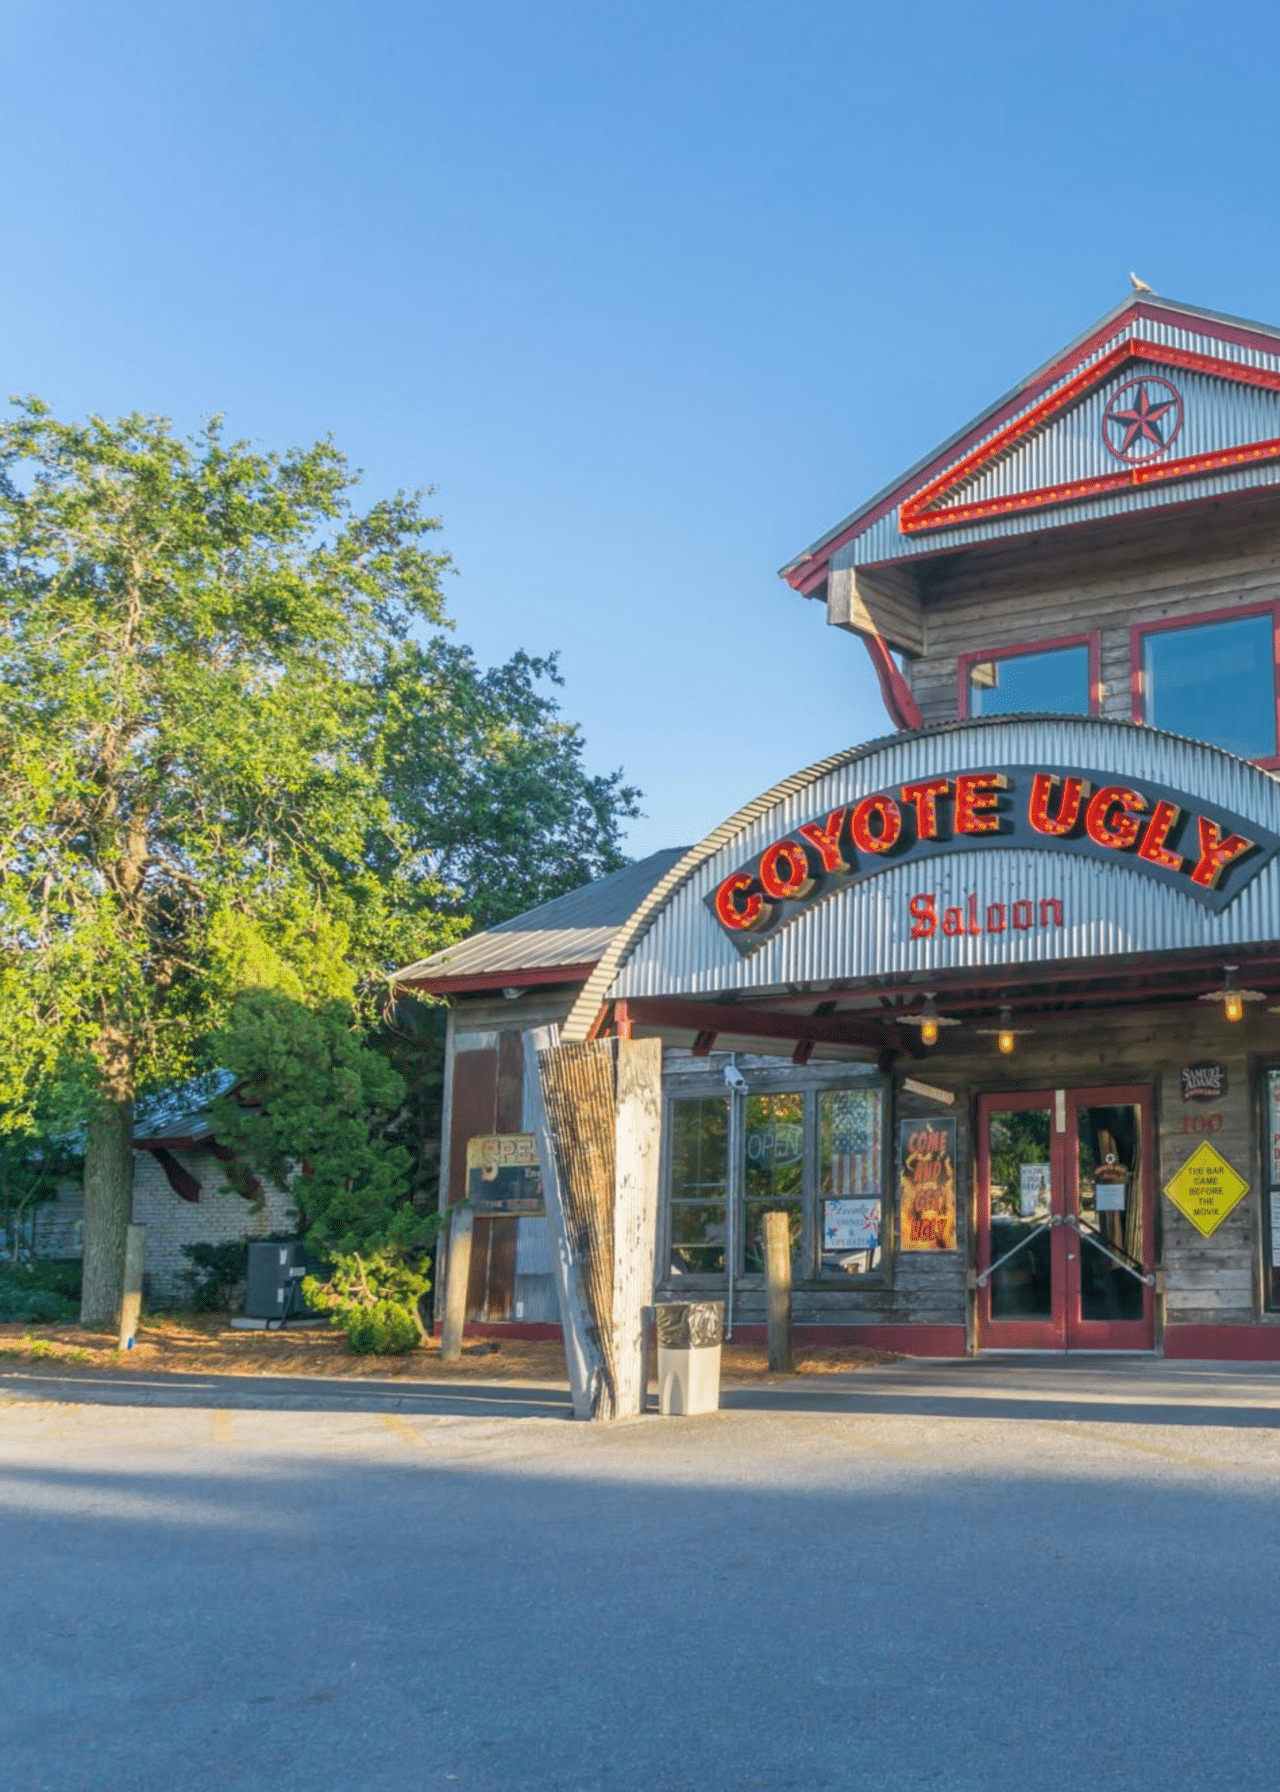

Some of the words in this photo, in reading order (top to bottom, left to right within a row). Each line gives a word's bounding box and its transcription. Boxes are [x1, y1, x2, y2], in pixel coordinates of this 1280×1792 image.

[714, 772, 1012, 932] COYOTE
[1028, 772, 1257, 891] UGLY
[909, 892, 1064, 940] Saloon
[1182, 1066, 1224, 1082] SAMUEL
[1185, 1076, 1222, 1091] ADAMS
[1182, 1113, 1224, 1134] 100
[747, 1132, 800, 1160] OPEN
[907, 1131, 948, 1153] COME
[481, 1139, 536, 1181] SPE
[1188, 1166, 1205, 1175] THE
[1206, 1166, 1225, 1175] BAR
[1193, 1176, 1220, 1185] CAME
[1189, 1187, 1225, 1196] BEFORE
[1198, 1197, 1215, 1206] THE
[1193, 1207, 1221, 1217] MOVIE
